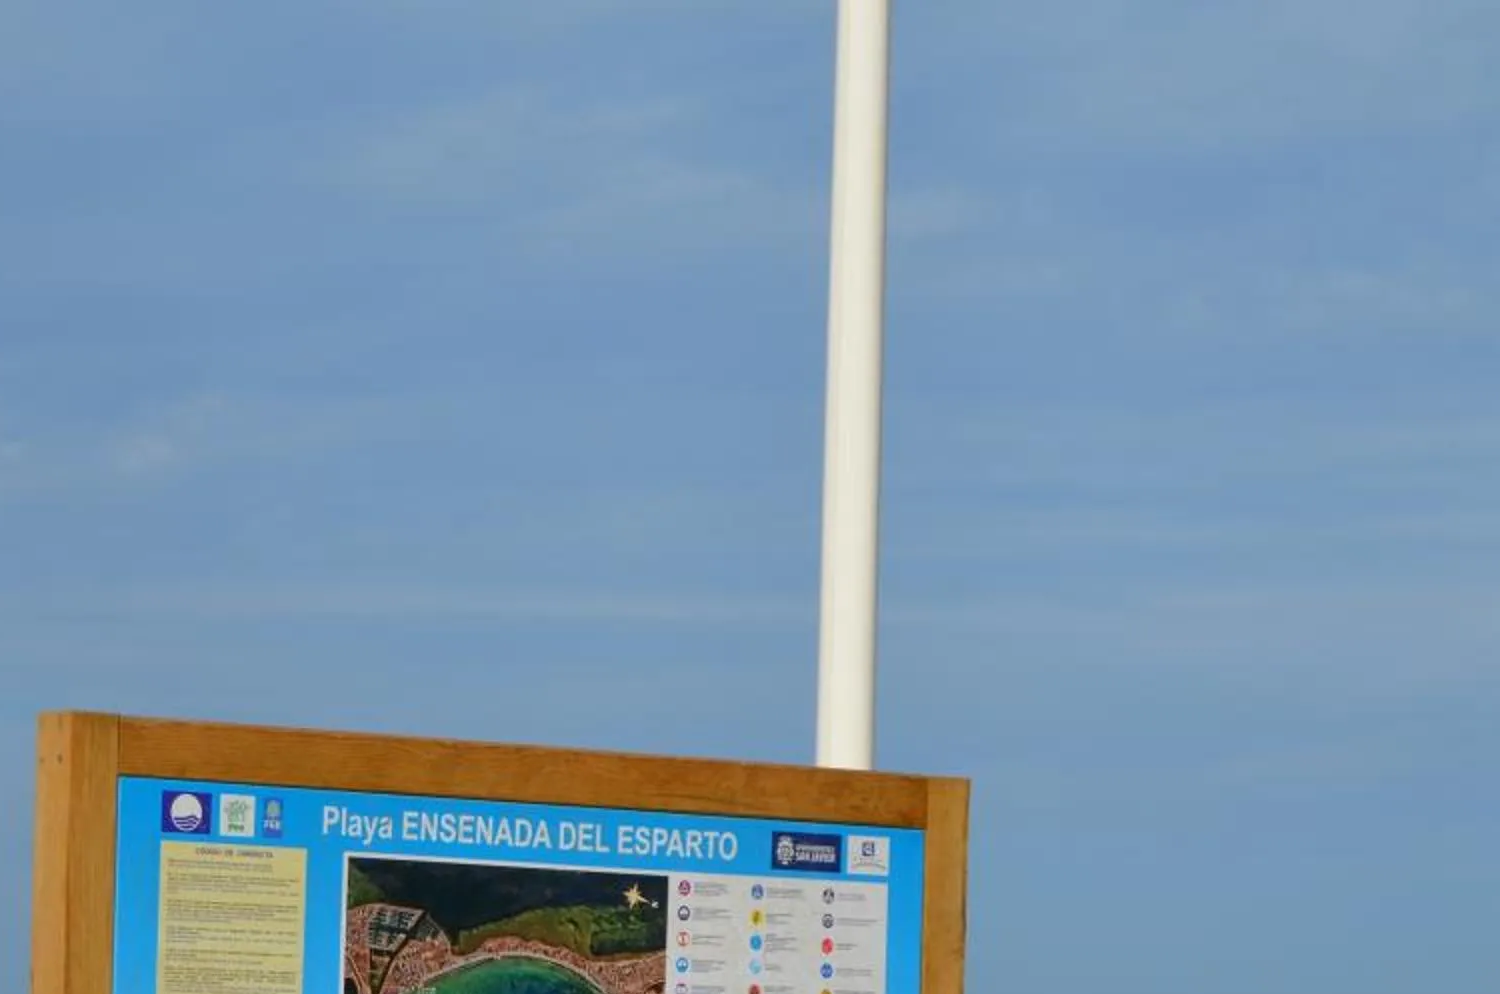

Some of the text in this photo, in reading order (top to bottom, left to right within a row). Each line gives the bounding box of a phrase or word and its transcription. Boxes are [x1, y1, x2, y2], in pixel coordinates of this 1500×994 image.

[321, 804, 738, 861] Playa ENSENADA DEL ESPARTO
